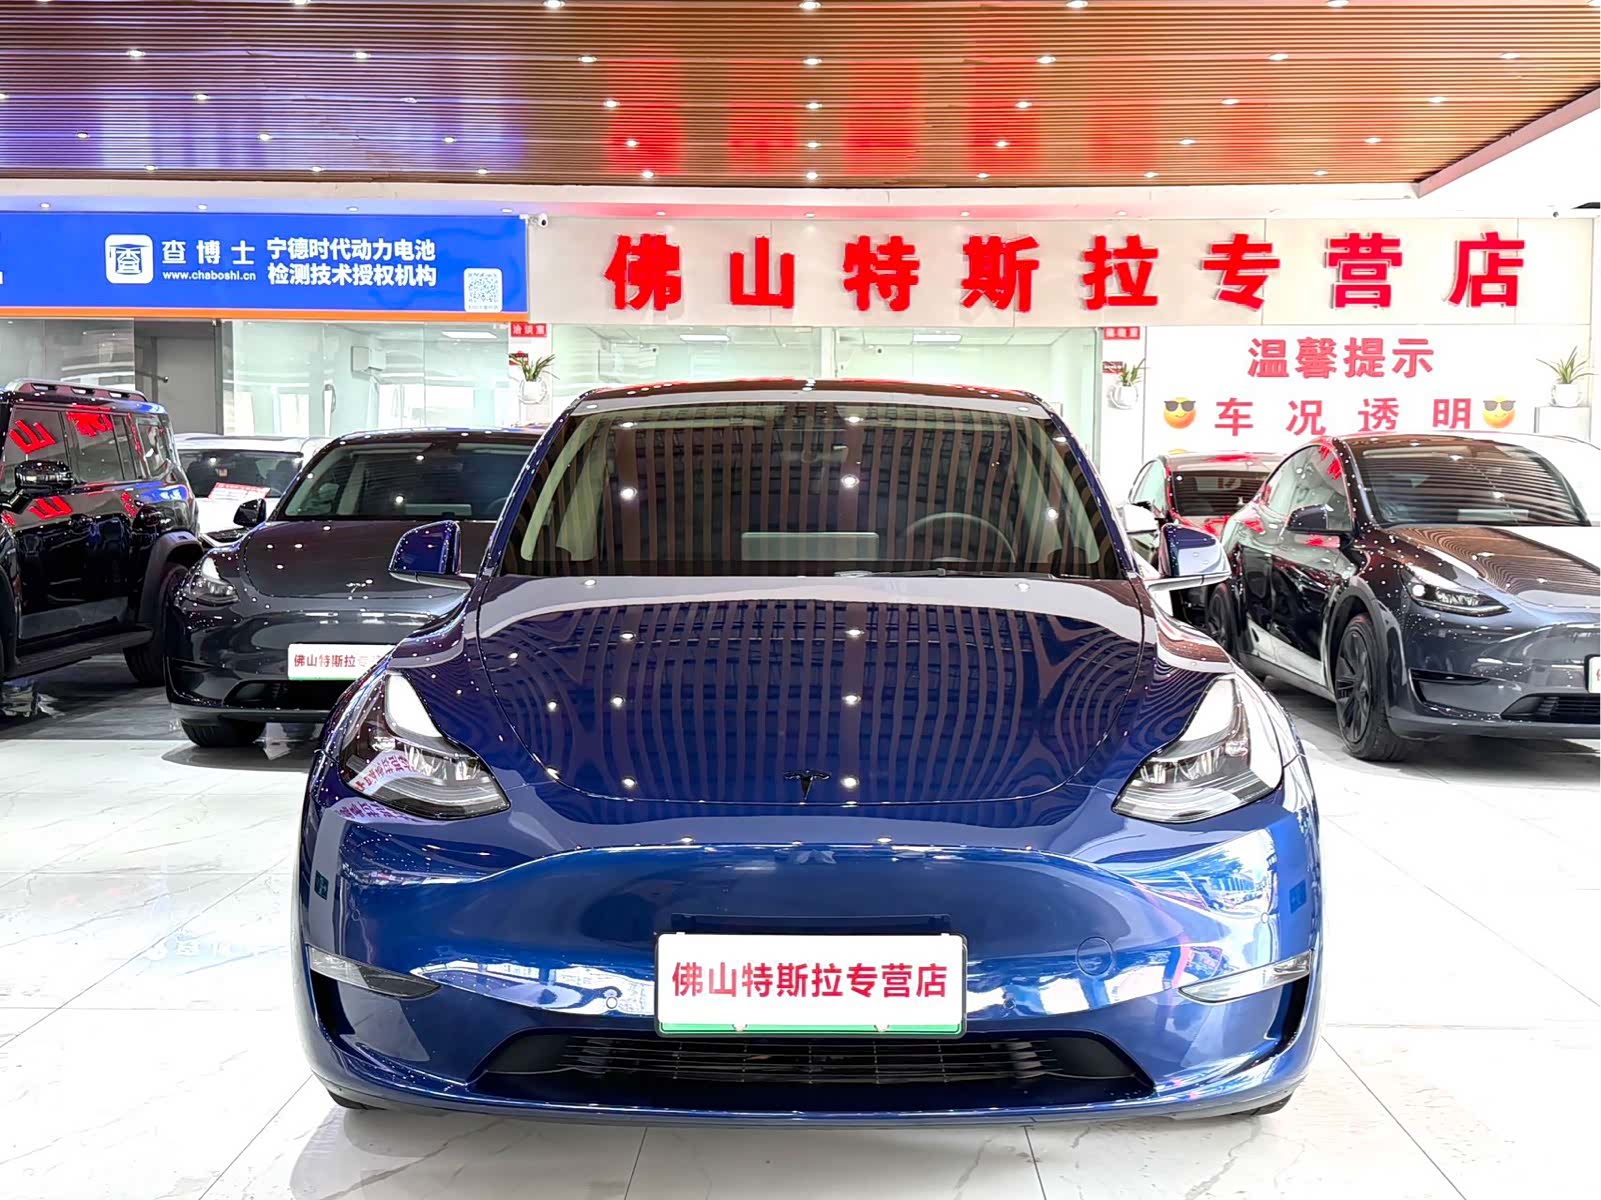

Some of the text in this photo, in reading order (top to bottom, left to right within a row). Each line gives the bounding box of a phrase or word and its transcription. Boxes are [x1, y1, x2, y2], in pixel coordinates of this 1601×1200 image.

[161, 239, 256, 265] 查博士
[266, 236, 436, 261] 宁德时代动力电池
[162, 270, 256, 281] www.chaboshi.cn
[267, 262, 437, 286] 检测技术授权机构
[604, 232, 1526, 313] 佛山特斯拉专营店
[1247, 336, 1434, 379] 温馨提示
[1214, 397, 1472, 437] 车况透明
[672, 961, 948, 998] 佛山特斯拉专营店
